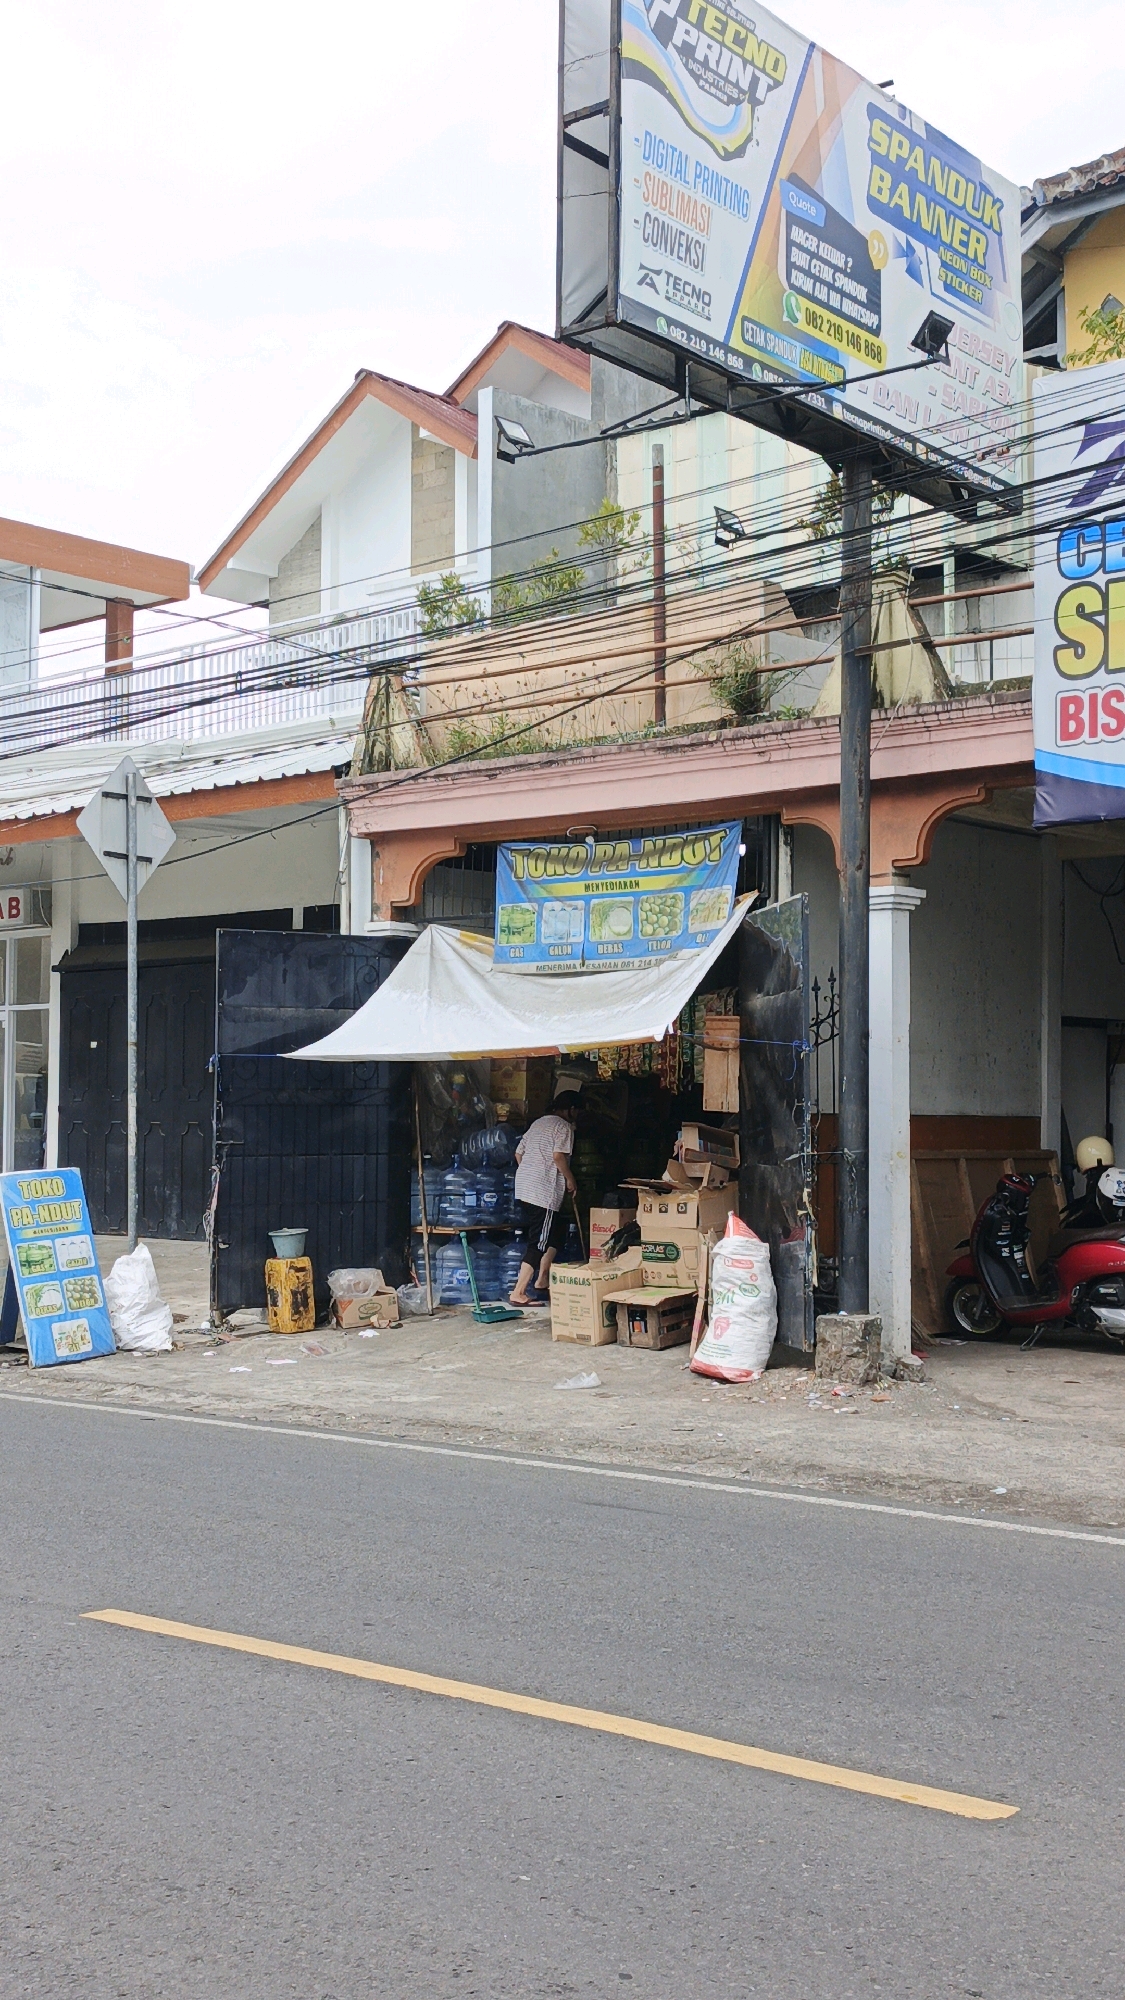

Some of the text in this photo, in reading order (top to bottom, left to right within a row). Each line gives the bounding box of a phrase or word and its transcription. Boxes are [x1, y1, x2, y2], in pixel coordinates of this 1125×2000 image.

[671, 16, 774, 102] PRINT
[687, 0, 787, 83] TECNO
[687, 57, 739, 99] INDUSTRIES
[642, 130, 750, 219] DIGITAL PRINTING
[869, 118, 1003, 233] SPANDUK
[642, 171, 711, 236] SUBLIMASI
[788, 191, 817, 217] Quote
[869, 164, 988, 268] BANNER
[642, 211, 707, 272] CONVEKSI
[790, 224, 818, 254] MAGER
[818, 240, 846, 271] KELUAR
[664, 270, 712, 308] TECNO
[790, 246, 868, 304] BUAT CETAK SPANDUK
[938, 267, 984, 305] STICKER
[939, 245, 993, 290] NEON BOX
[790, 268, 879, 330] KIRIM AJA VIA WHATSAPP
[669, 325, 743, 370] 082 219 146 868
[743, 320, 798, 365] CETAK SPANDUK
[804, 306, 883, 364] 082 219 146 868
[948, 323, 1018, 377] JERSEY
[872, 379, 919, 424] DAN
[511, 830, 729, 880] TOKO PA-NDUT
[584, 879, 640, 893] MENYEDIAKAN
[510, 946, 524, 958] GAS
[549, 944, 573, 956] GALON
[536, 963, 577, 973] MENERIMA
[18, 1178, 65, 1200] TOKO
[10, 1201, 82, 1228] PA-NDUT
